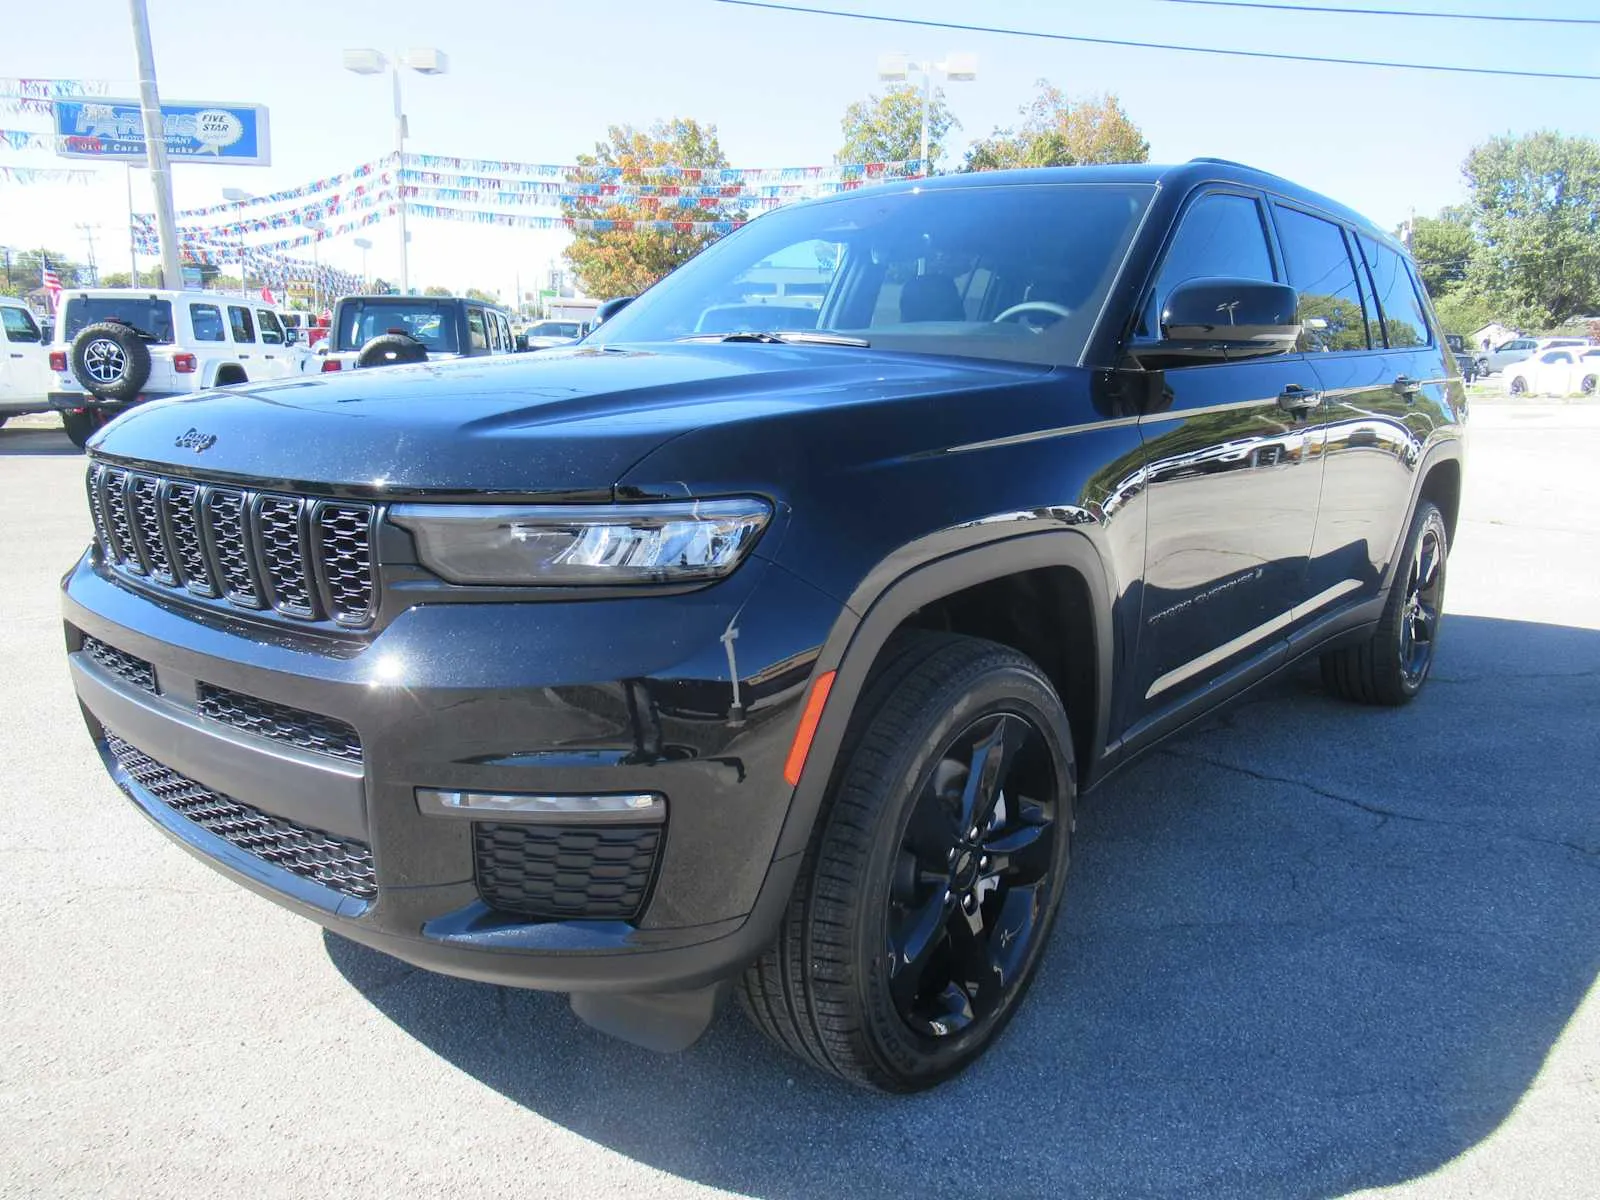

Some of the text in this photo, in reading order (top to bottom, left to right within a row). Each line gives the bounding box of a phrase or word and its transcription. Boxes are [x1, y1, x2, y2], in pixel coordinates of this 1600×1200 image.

[202, 114, 226, 122] FIVE
[202, 123, 229, 132] STAR
[114, 144, 139, 152] Cars
[175, 427, 217, 453] Jeep
